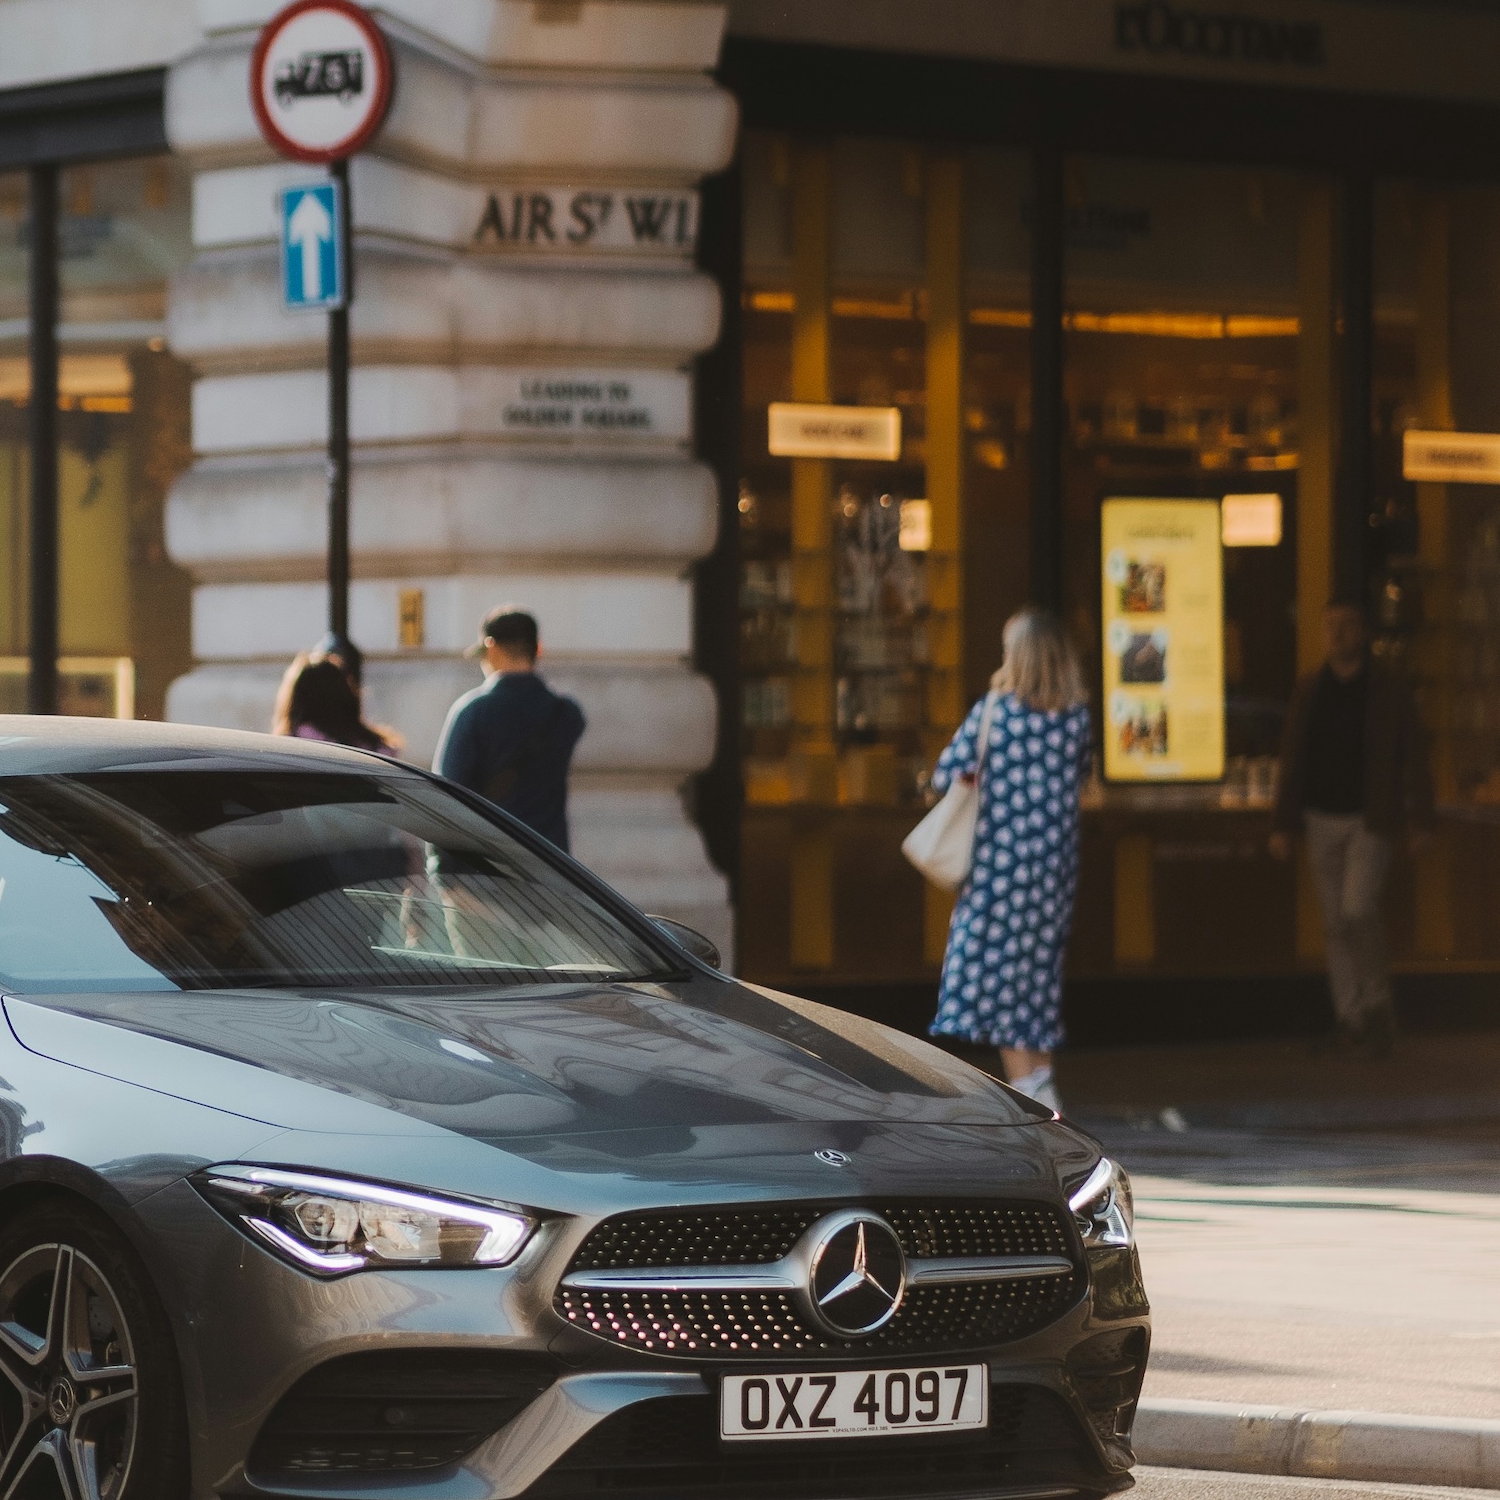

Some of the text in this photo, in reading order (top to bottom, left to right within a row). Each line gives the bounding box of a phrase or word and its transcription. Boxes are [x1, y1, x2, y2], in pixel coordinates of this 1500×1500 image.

[475, 191, 555, 243] AIR
[741, 1368, 969, 1431] OXZ 4097
